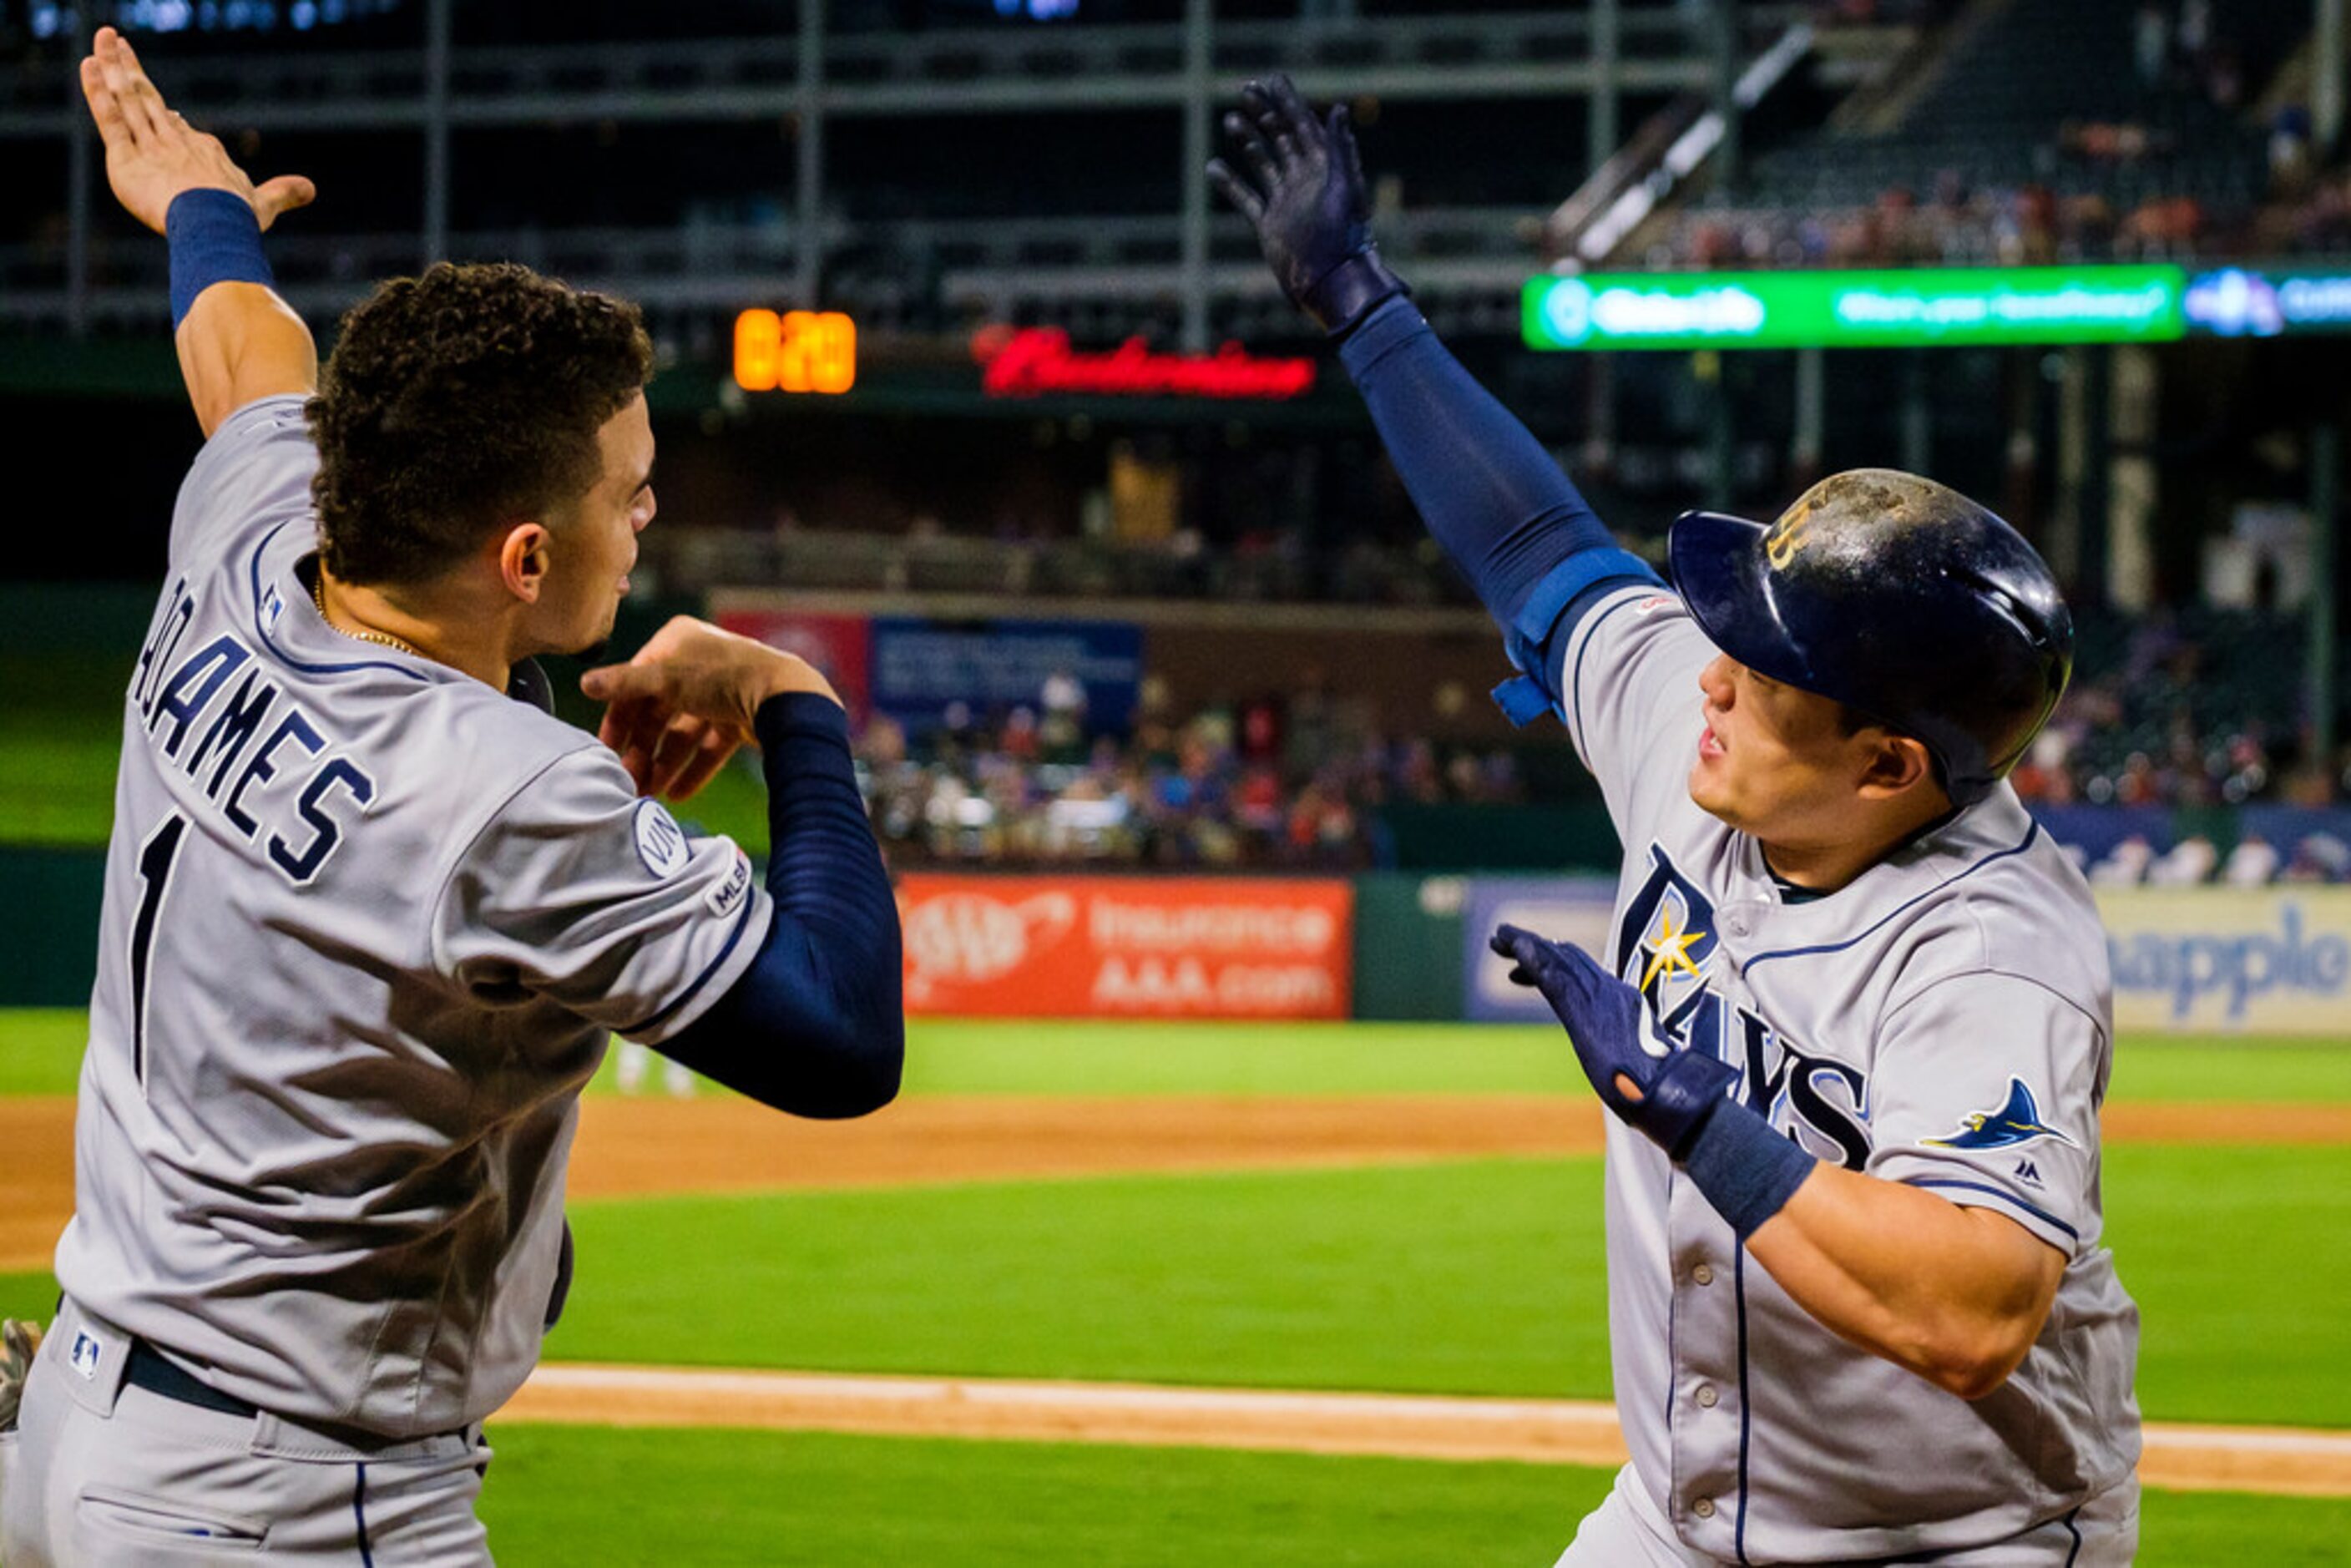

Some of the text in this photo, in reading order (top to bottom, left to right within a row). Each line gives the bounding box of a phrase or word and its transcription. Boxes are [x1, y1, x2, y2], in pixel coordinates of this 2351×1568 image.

[130, 810, 190, 1090] 1
[1088, 898, 1336, 953] Insurance
[1092, 956, 1336, 1010] AAA.com
